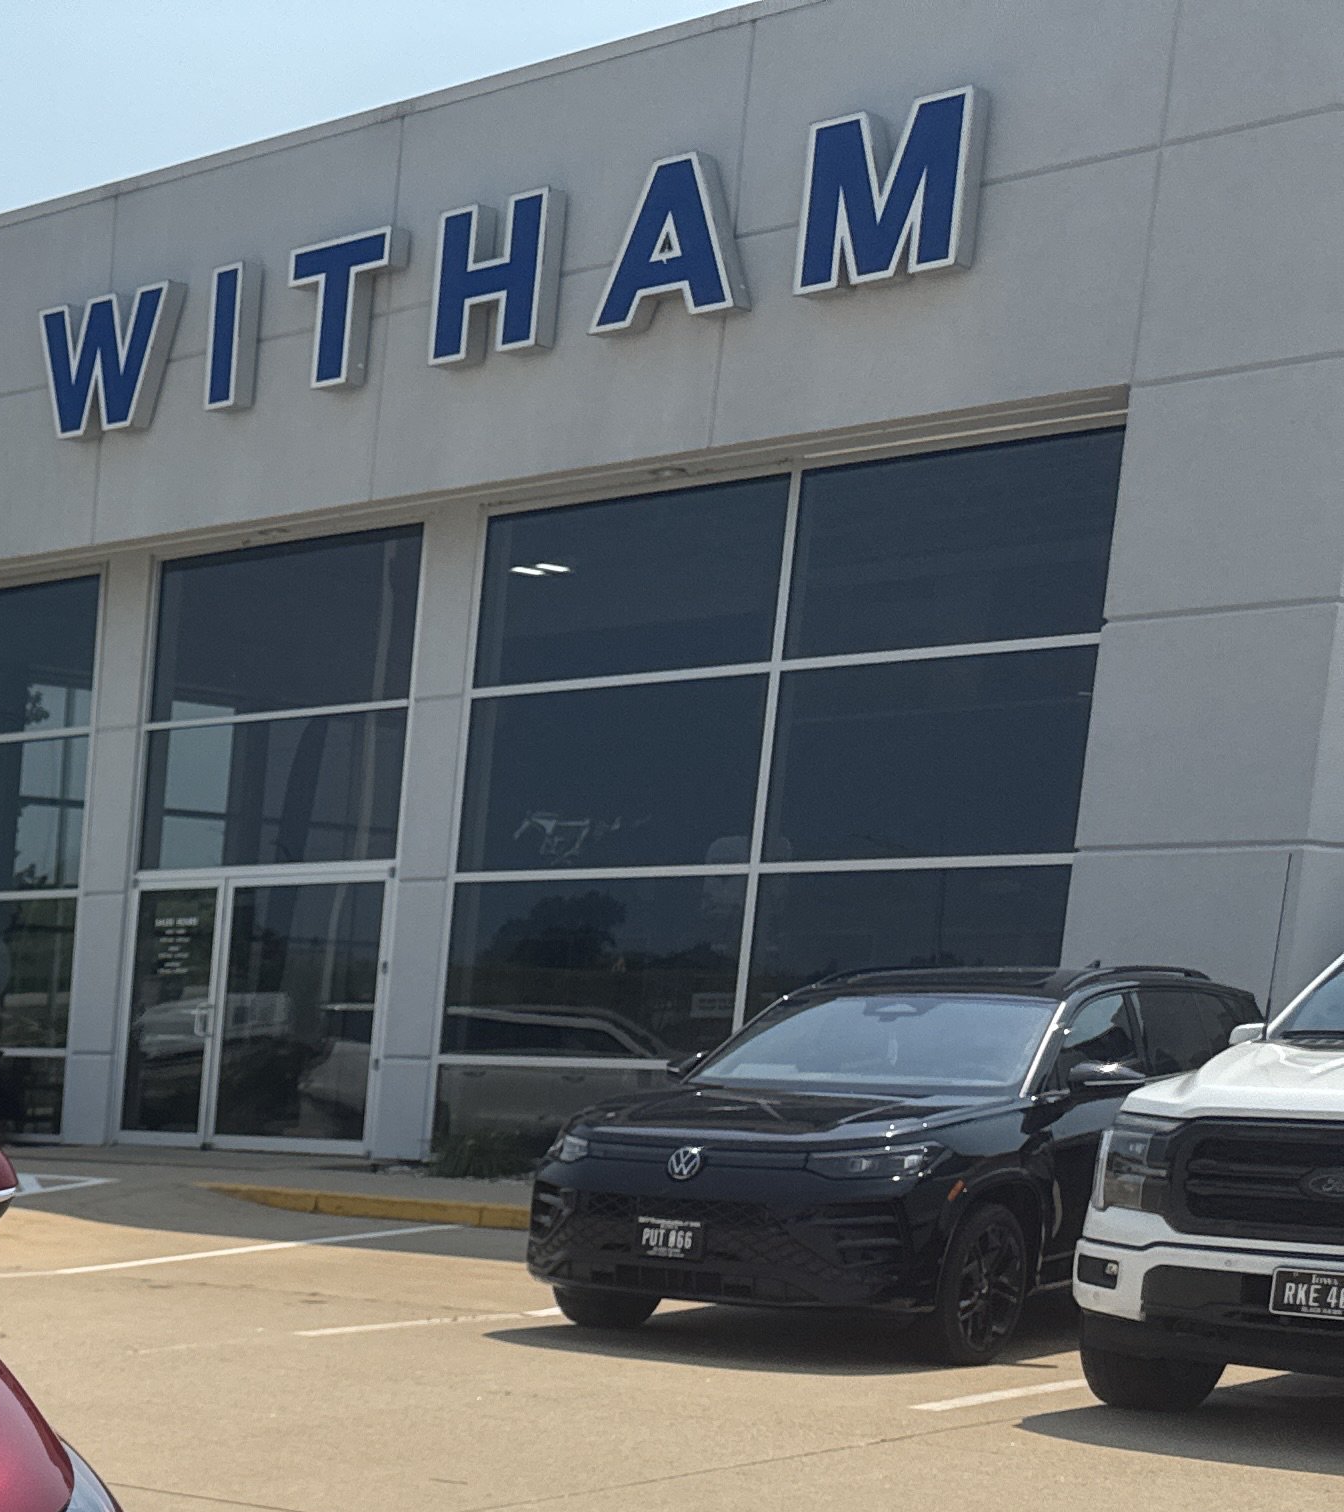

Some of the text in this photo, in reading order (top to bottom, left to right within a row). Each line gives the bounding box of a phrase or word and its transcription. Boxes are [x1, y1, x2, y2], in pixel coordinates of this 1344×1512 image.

[40, 86, 986, 440] WITHAM
[641, 1228, 665, 1247] PUT
[1283, 1282, 1322, 1307] RKE
